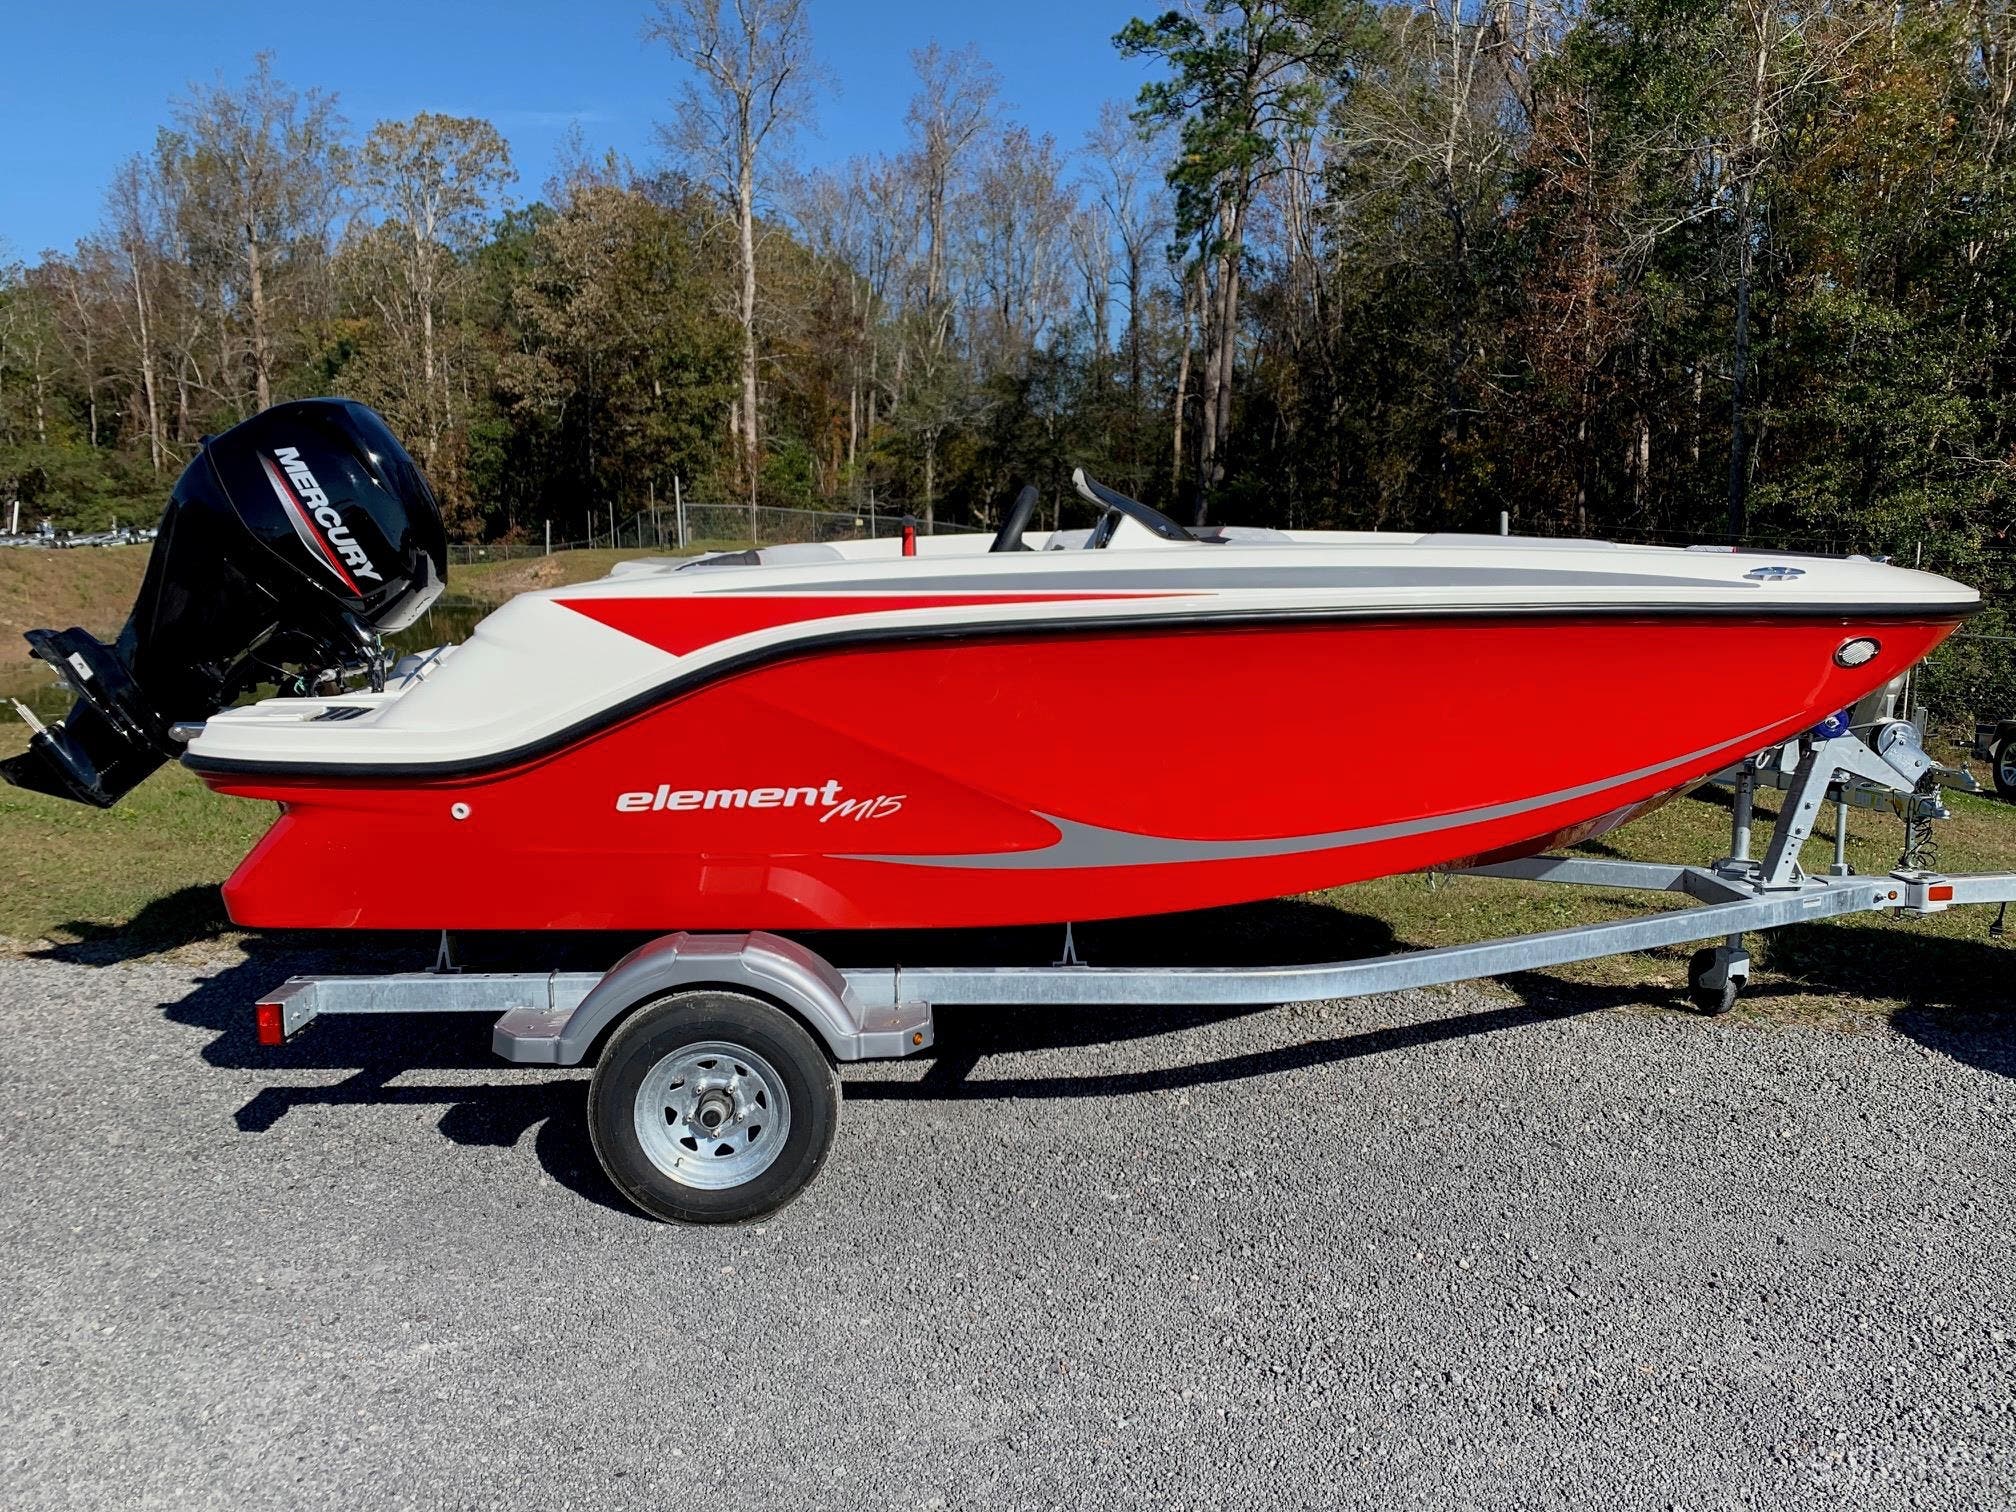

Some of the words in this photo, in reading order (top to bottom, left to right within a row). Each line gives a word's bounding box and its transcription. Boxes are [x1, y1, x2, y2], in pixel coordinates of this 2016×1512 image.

[274, 447, 383, 581] MERCURY
[616, 780, 843, 812] element
[819, 795, 907, 823] M15
